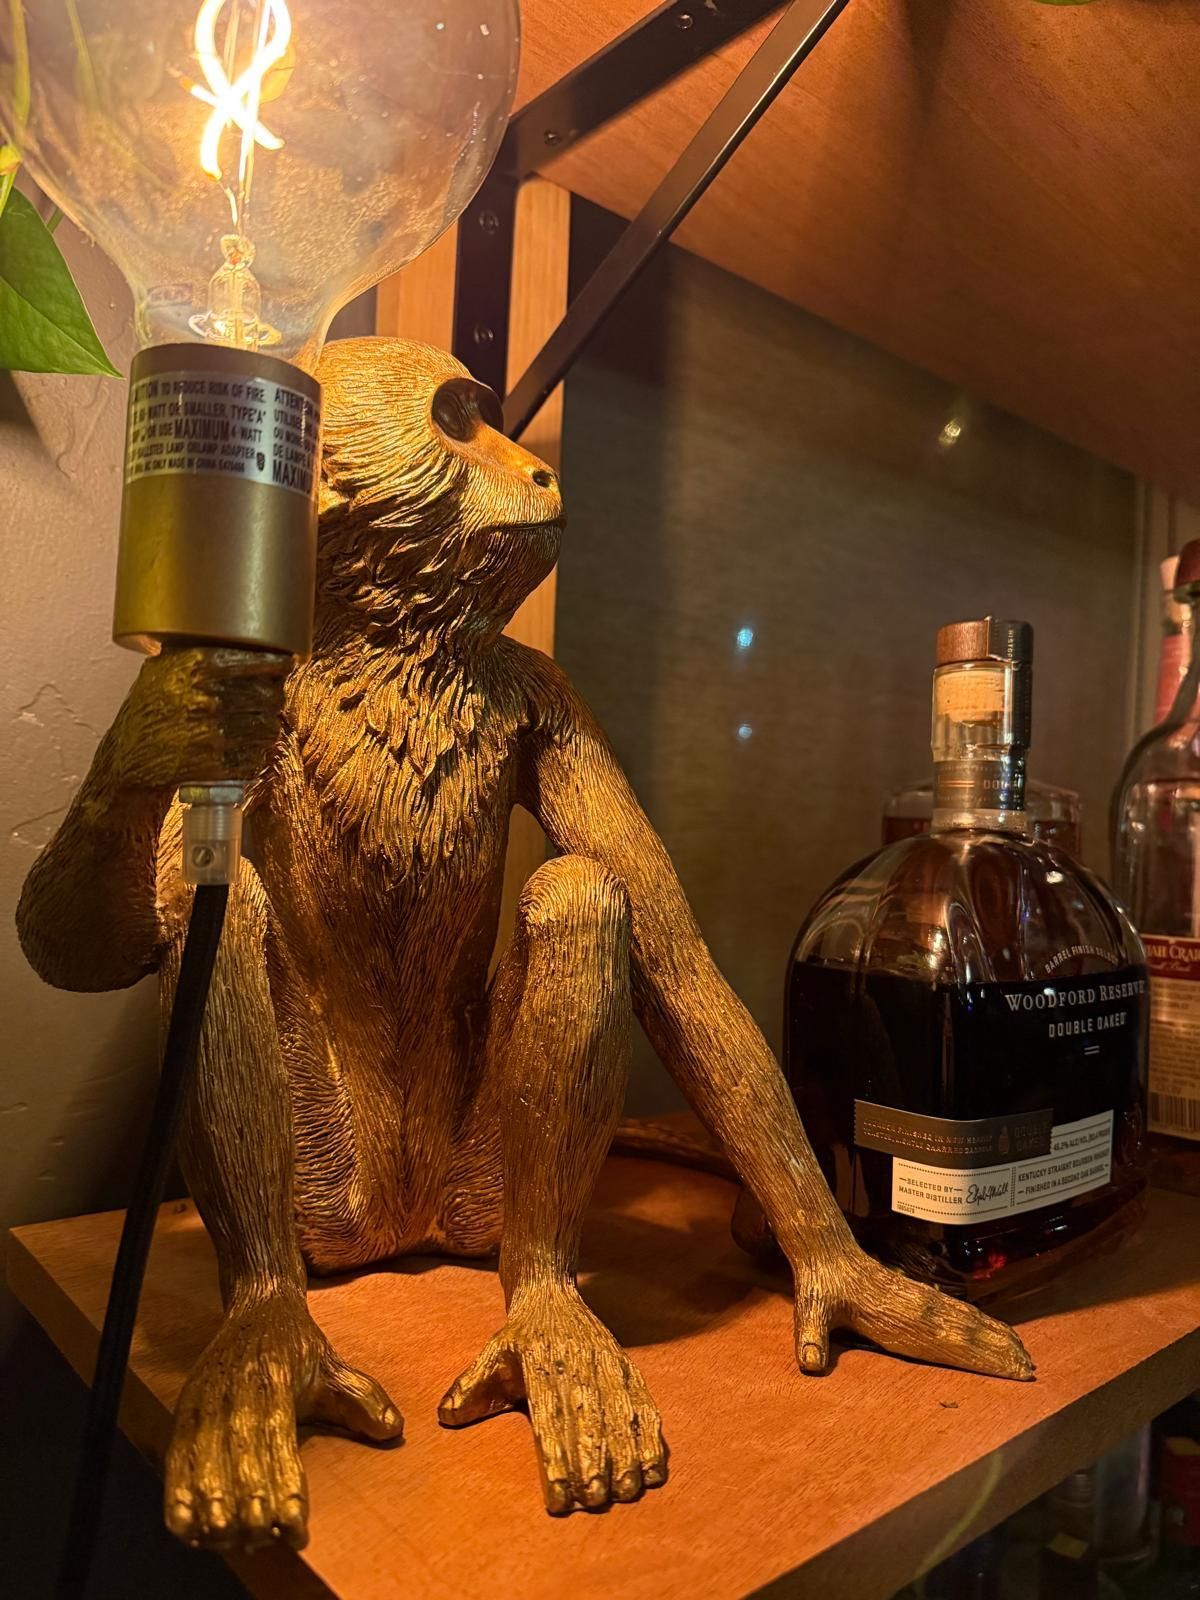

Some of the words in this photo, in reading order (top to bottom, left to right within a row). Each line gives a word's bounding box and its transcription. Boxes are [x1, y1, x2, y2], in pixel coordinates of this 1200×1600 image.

[231, 383, 245, 398] OF
[174, 418, 230, 441] MAXIMUM
[240, 427, 263, 443] WATT
[1044, 947, 1072, 974] BARREL
[1004, 988, 1096, 1012] WOODFORD
[1099, 980, 1145, 1002] RESERVE
[1048, 1018, 1093, 1038] DOUBLE
[1018, 1167, 1047, 1182] KENTUCKY
[1047, 1160, 1072, 1175] STRAIGHT
[898, 1185, 924, 1198] MASTER
[925, 1191, 963, 1204] DISTILLER
[907, 1178, 942, 1192] SELECTED
[943, 1185, 954, 1193] BY
[1025, 1180, 1051, 1195] FINISHED
[1061, 1172, 1080, 1185] SECOND
